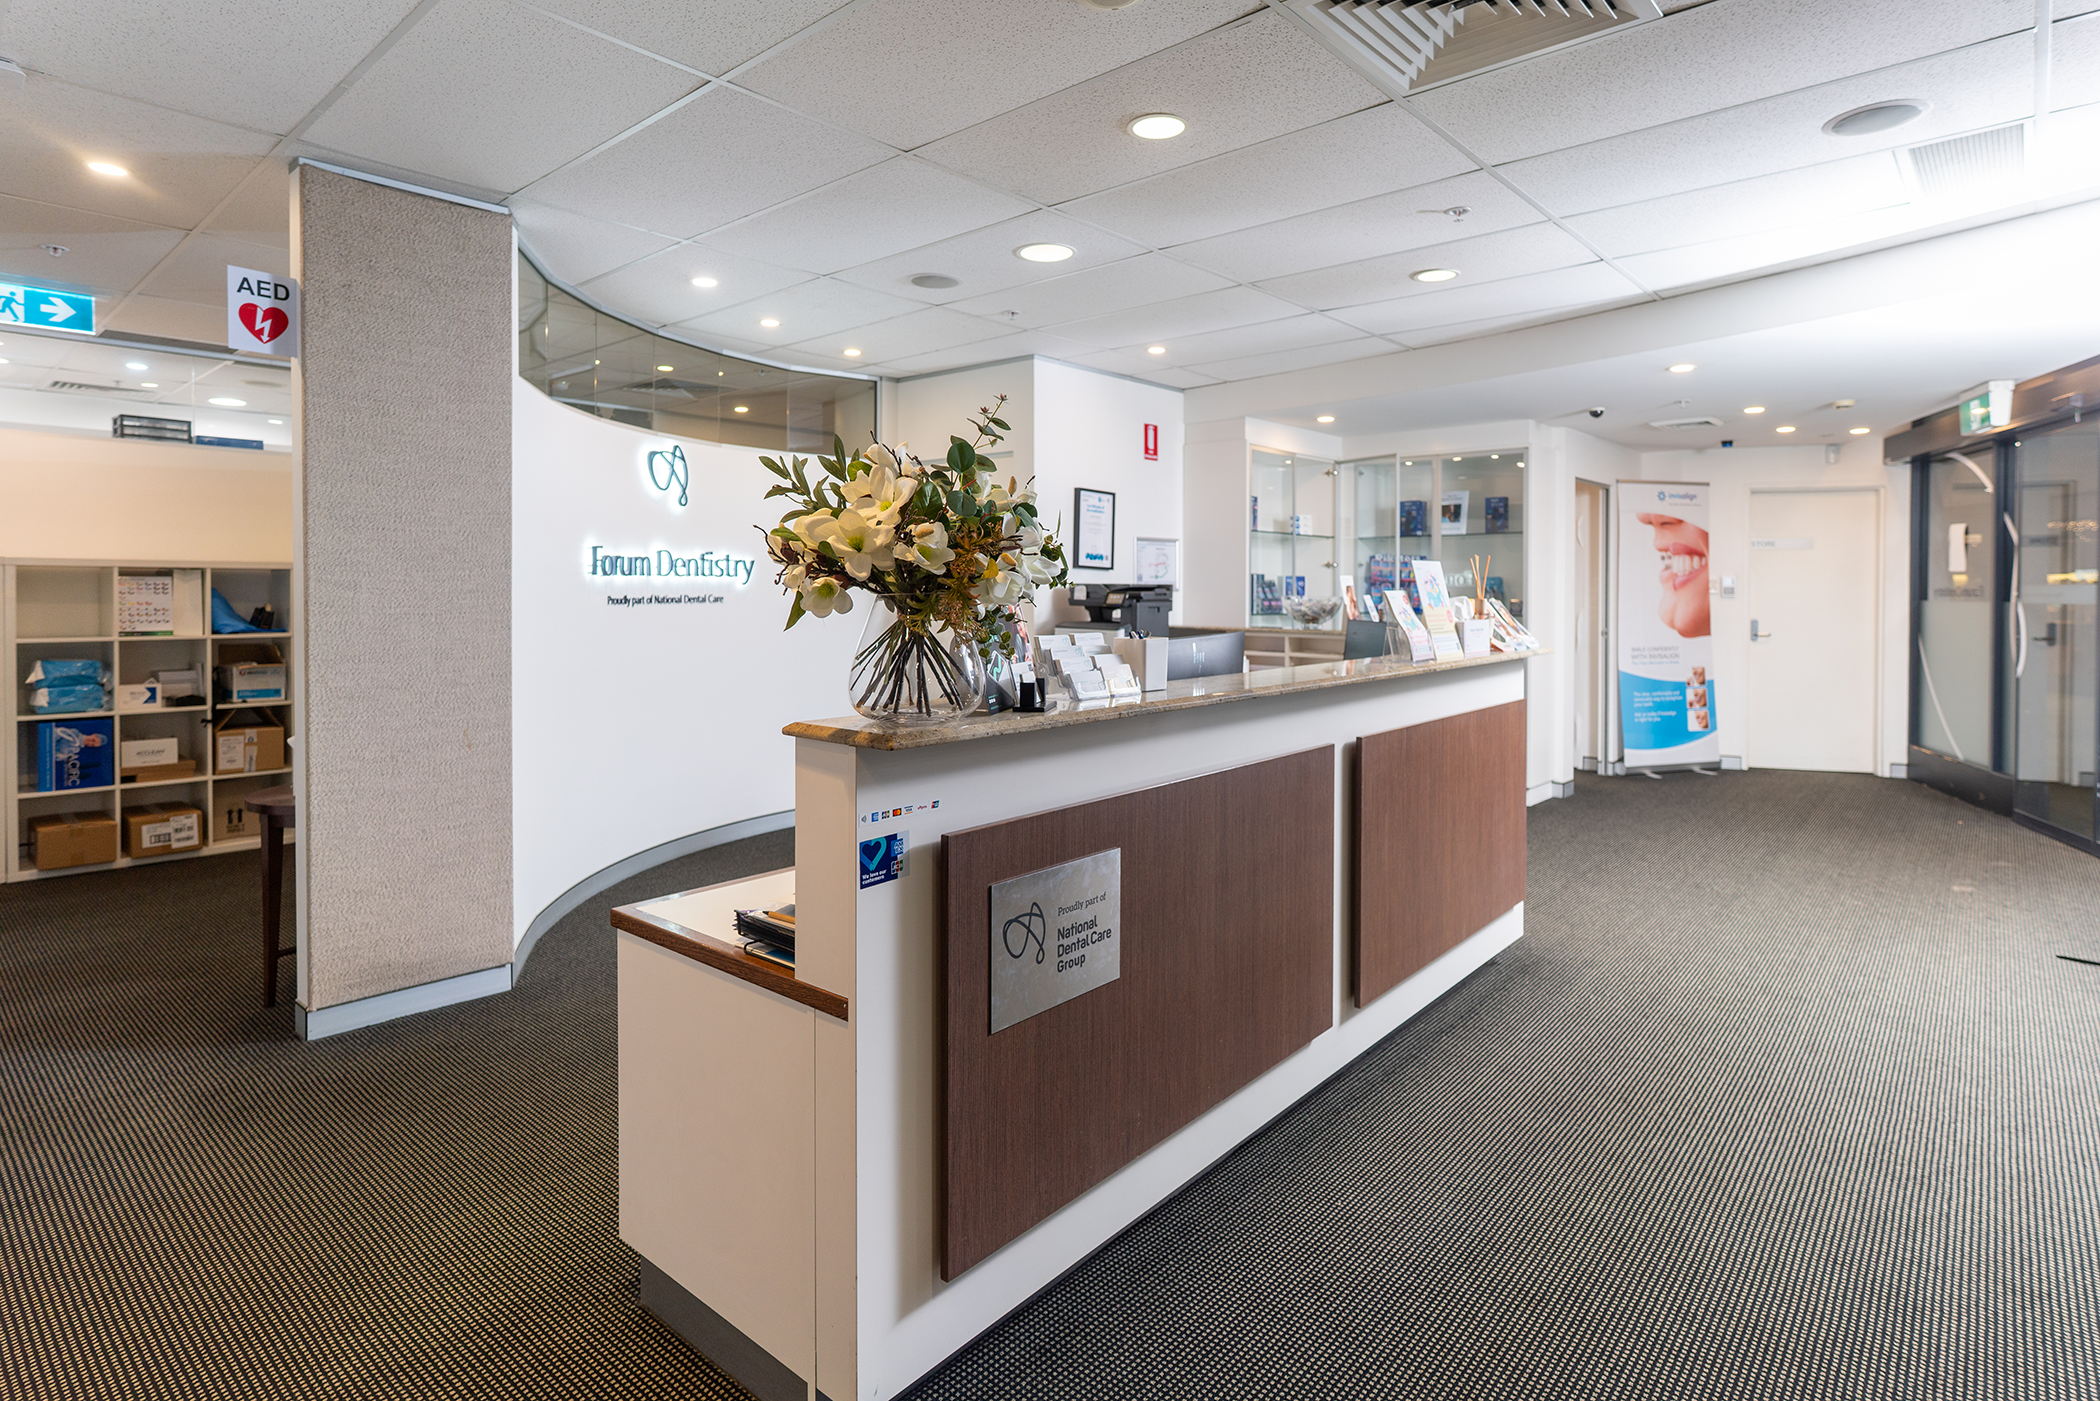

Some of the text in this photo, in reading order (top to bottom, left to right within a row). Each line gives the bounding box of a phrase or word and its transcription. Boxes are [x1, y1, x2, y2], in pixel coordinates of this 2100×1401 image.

[237, 276, 290, 301] AED
[590, 545, 755, 585] Forum Dentistry
[607, 594, 724, 608] Proudly part of National Dental Care
[862, 875, 884, 884] customers
[1058, 892, 1106, 916] Proudly part of
[1058, 915, 1097, 941] National
[1058, 928, 1112, 958] Dental Care
[1057, 953, 1086, 973] Group
